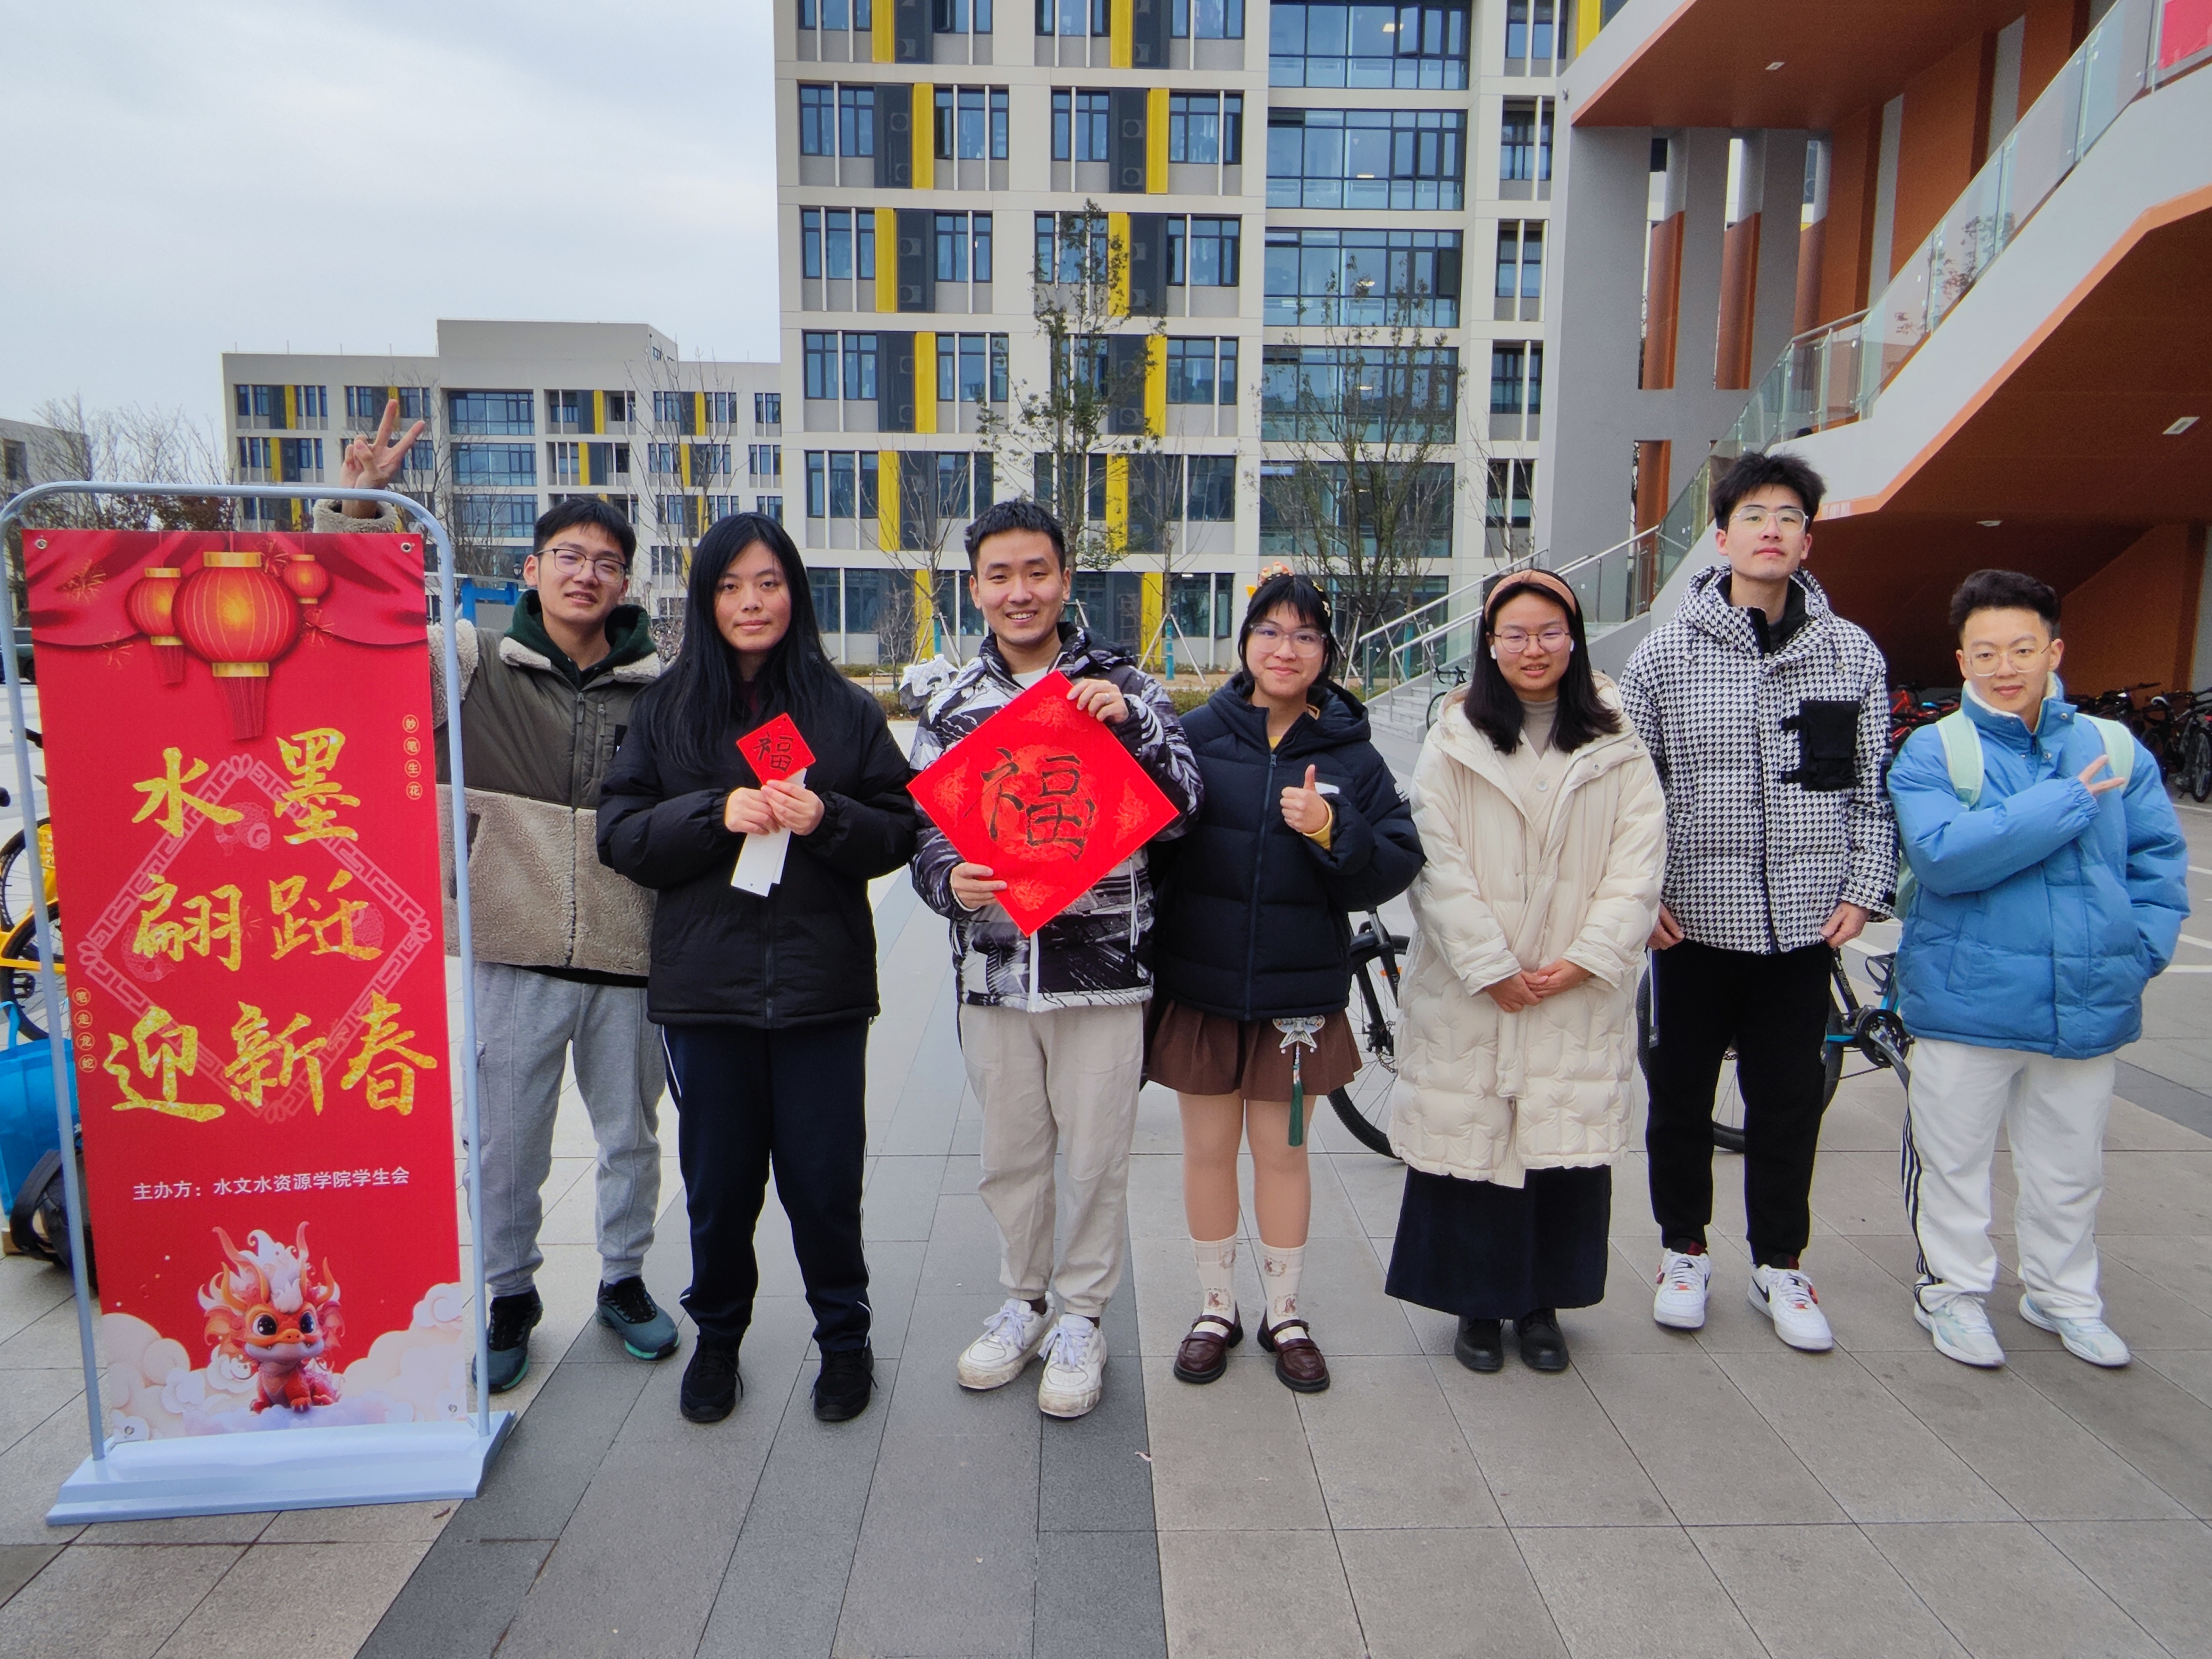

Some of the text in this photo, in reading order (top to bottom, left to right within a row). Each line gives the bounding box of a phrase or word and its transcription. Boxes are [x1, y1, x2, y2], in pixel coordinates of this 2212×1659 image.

[132, 727, 361, 845] 水墨
[403, 716, 422, 798] 妙笔生花
[753, 731, 794, 772] 福
[963, 747, 1095, 862] 福
[132, 869, 384, 973] 翩跹
[73, 989, 96, 1071] 笔走龙蛇
[103, 991, 438, 1122] 迎新春
